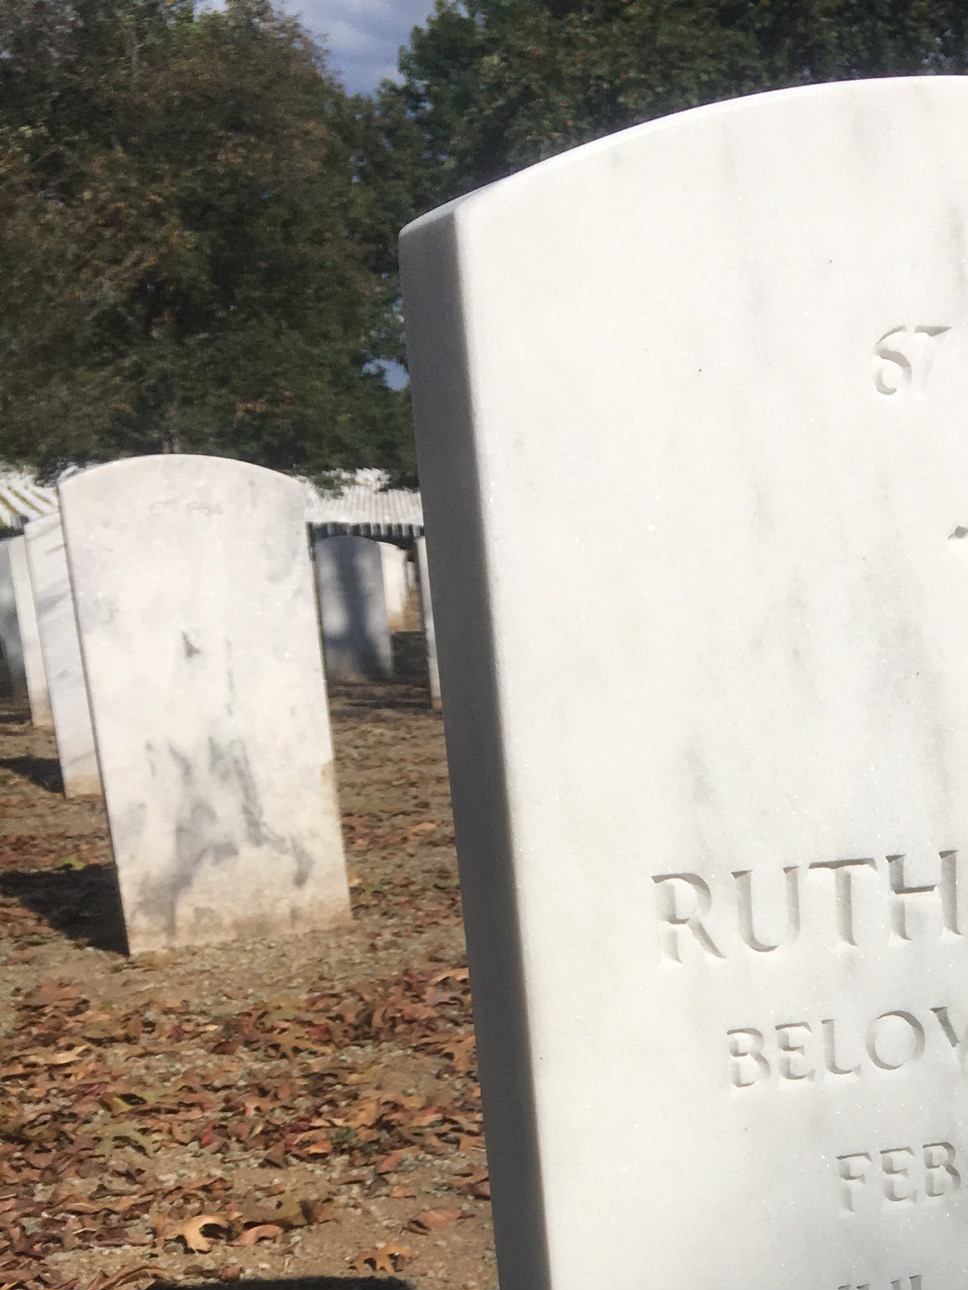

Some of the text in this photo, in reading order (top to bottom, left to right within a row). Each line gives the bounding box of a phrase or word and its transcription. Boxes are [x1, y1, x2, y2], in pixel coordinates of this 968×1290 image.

[871, 324, 952, 396] 67
[652, 850, 964, 965] RUTH
[835, 1141, 961, 1212] FEB
